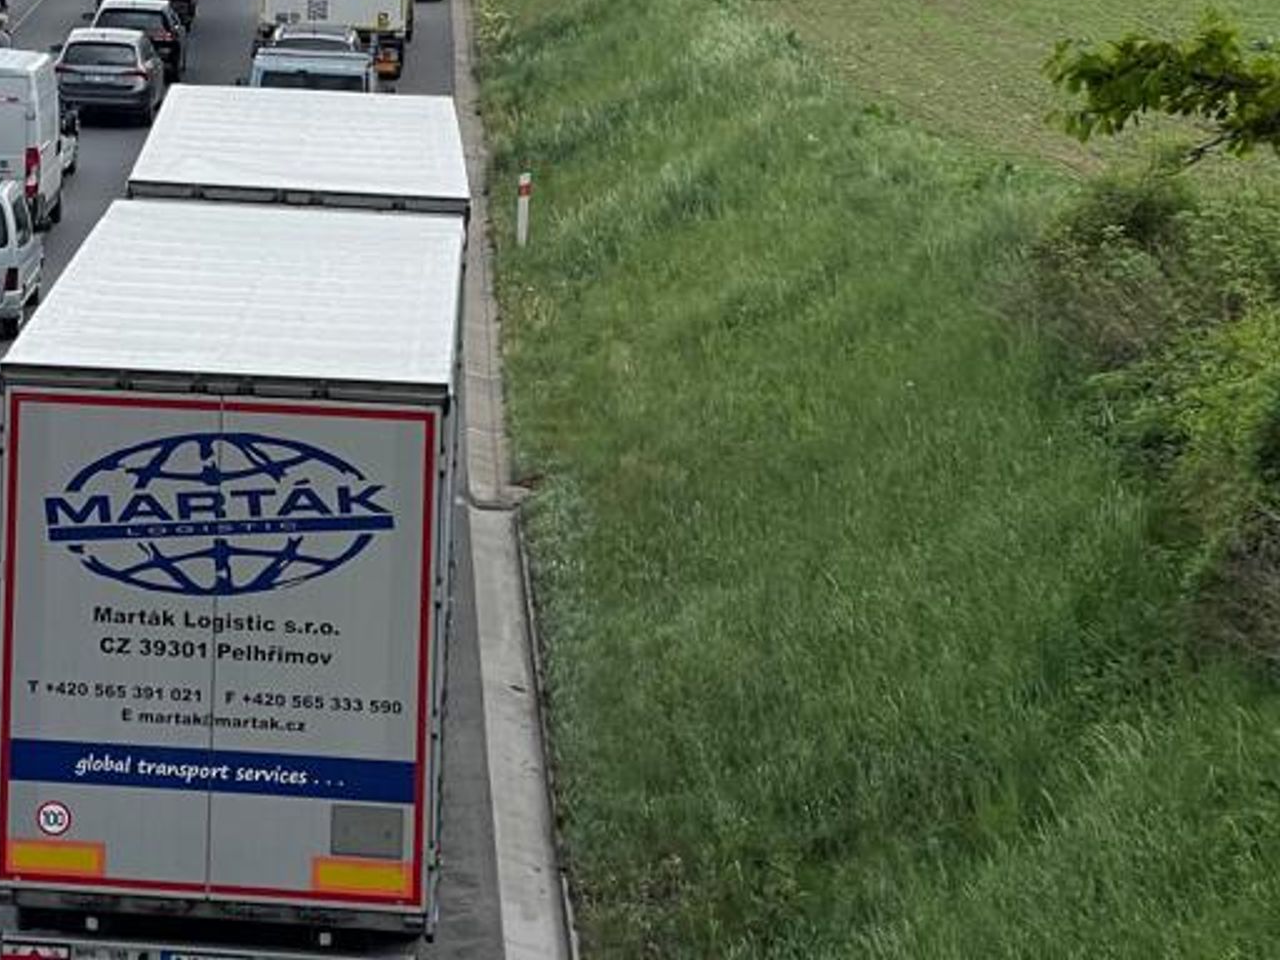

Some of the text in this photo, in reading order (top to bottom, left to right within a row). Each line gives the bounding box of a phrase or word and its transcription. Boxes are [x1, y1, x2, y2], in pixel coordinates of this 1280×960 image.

[44, 479, 391, 525] MARTÁK
[127, 522, 297, 536] LOGISTIC
[94, 606, 340, 636] Marták Logistic s.r.o.
[100, 637, 332, 665] CZ 39301 Pelhřimov
[27, 680, 202, 702] T +420 565 391 021
[225, 691, 402, 714] F +420 565 333 590
[121, 708, 133, 722] E
[75, 753, 132, 776] global
[137, 759, 230, 783] transport
[235, 765, 308, 784] services
